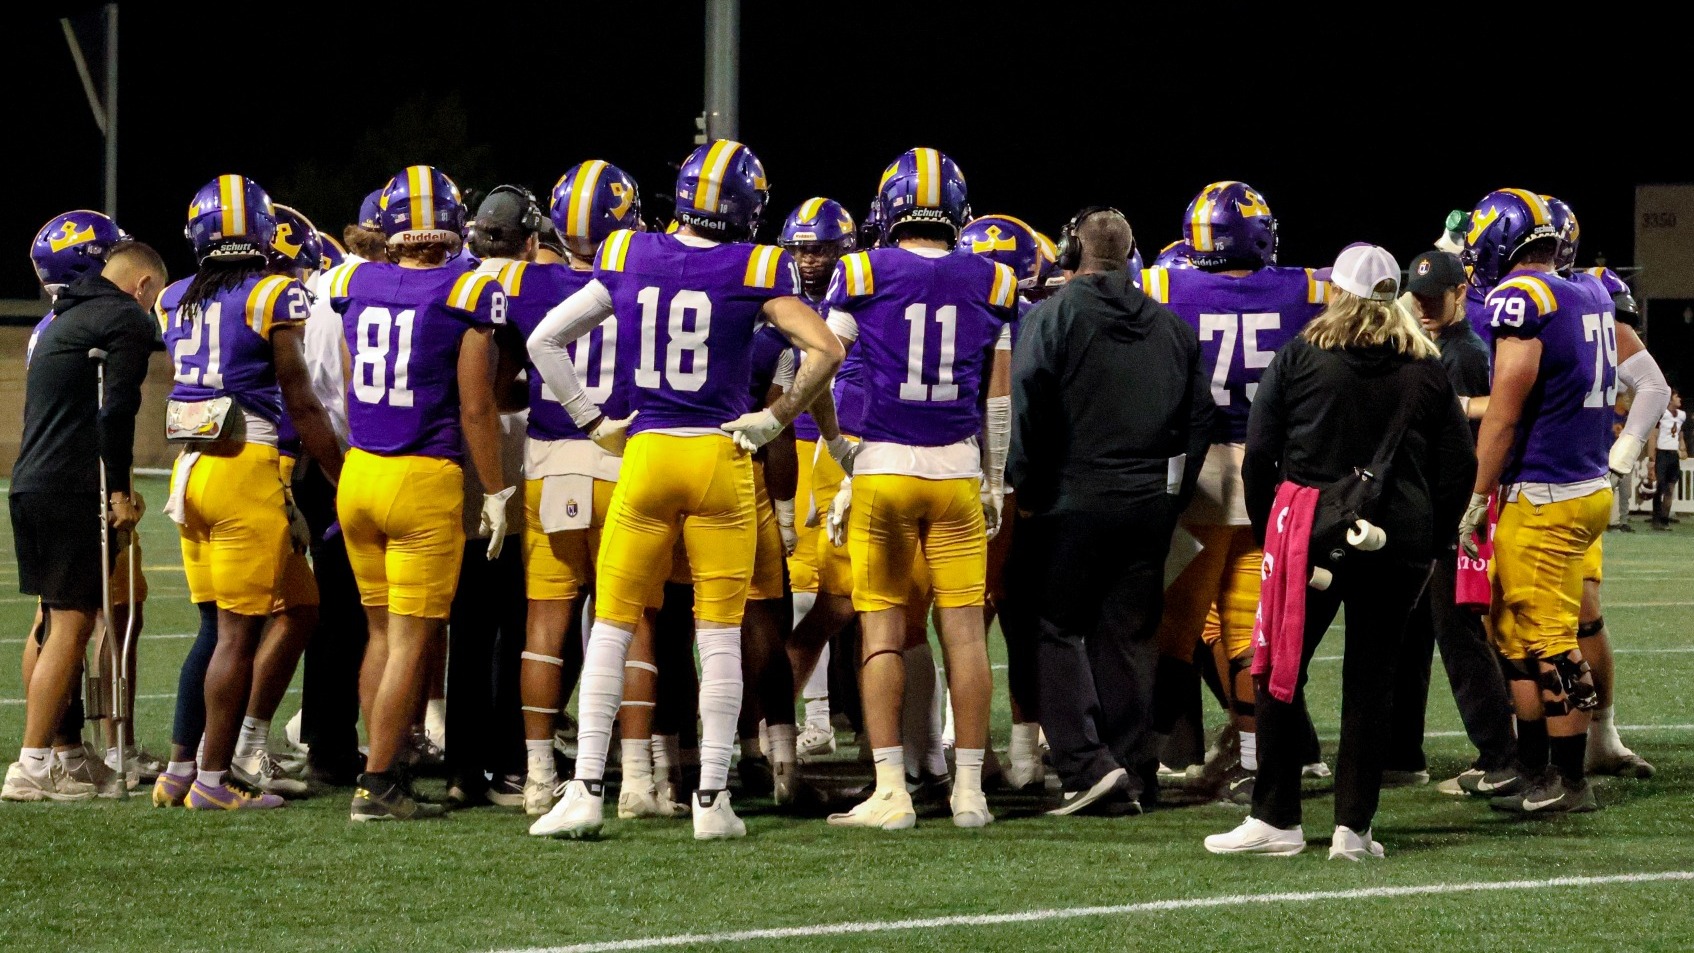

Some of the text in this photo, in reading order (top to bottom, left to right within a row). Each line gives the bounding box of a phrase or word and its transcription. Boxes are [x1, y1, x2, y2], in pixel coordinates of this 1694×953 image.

[682, 213, 726, 230] Riddell
[906, 194, 913, 204] 11
[912, 208, 943, 217] schutt
[220, 242, 251, 251] schutt
[403, 232, 447, 242] Riddell
[635, 286, 712, 392] 18
[1489, 297, 1526, 328] 79
[174, 301, 224, 389] 21
[353, 307, 416, 407] 81
[899, 303, 959, 401] 11
[1199, 312, 1280, 406] 75
[1582, 312, 1618, 408] 79
